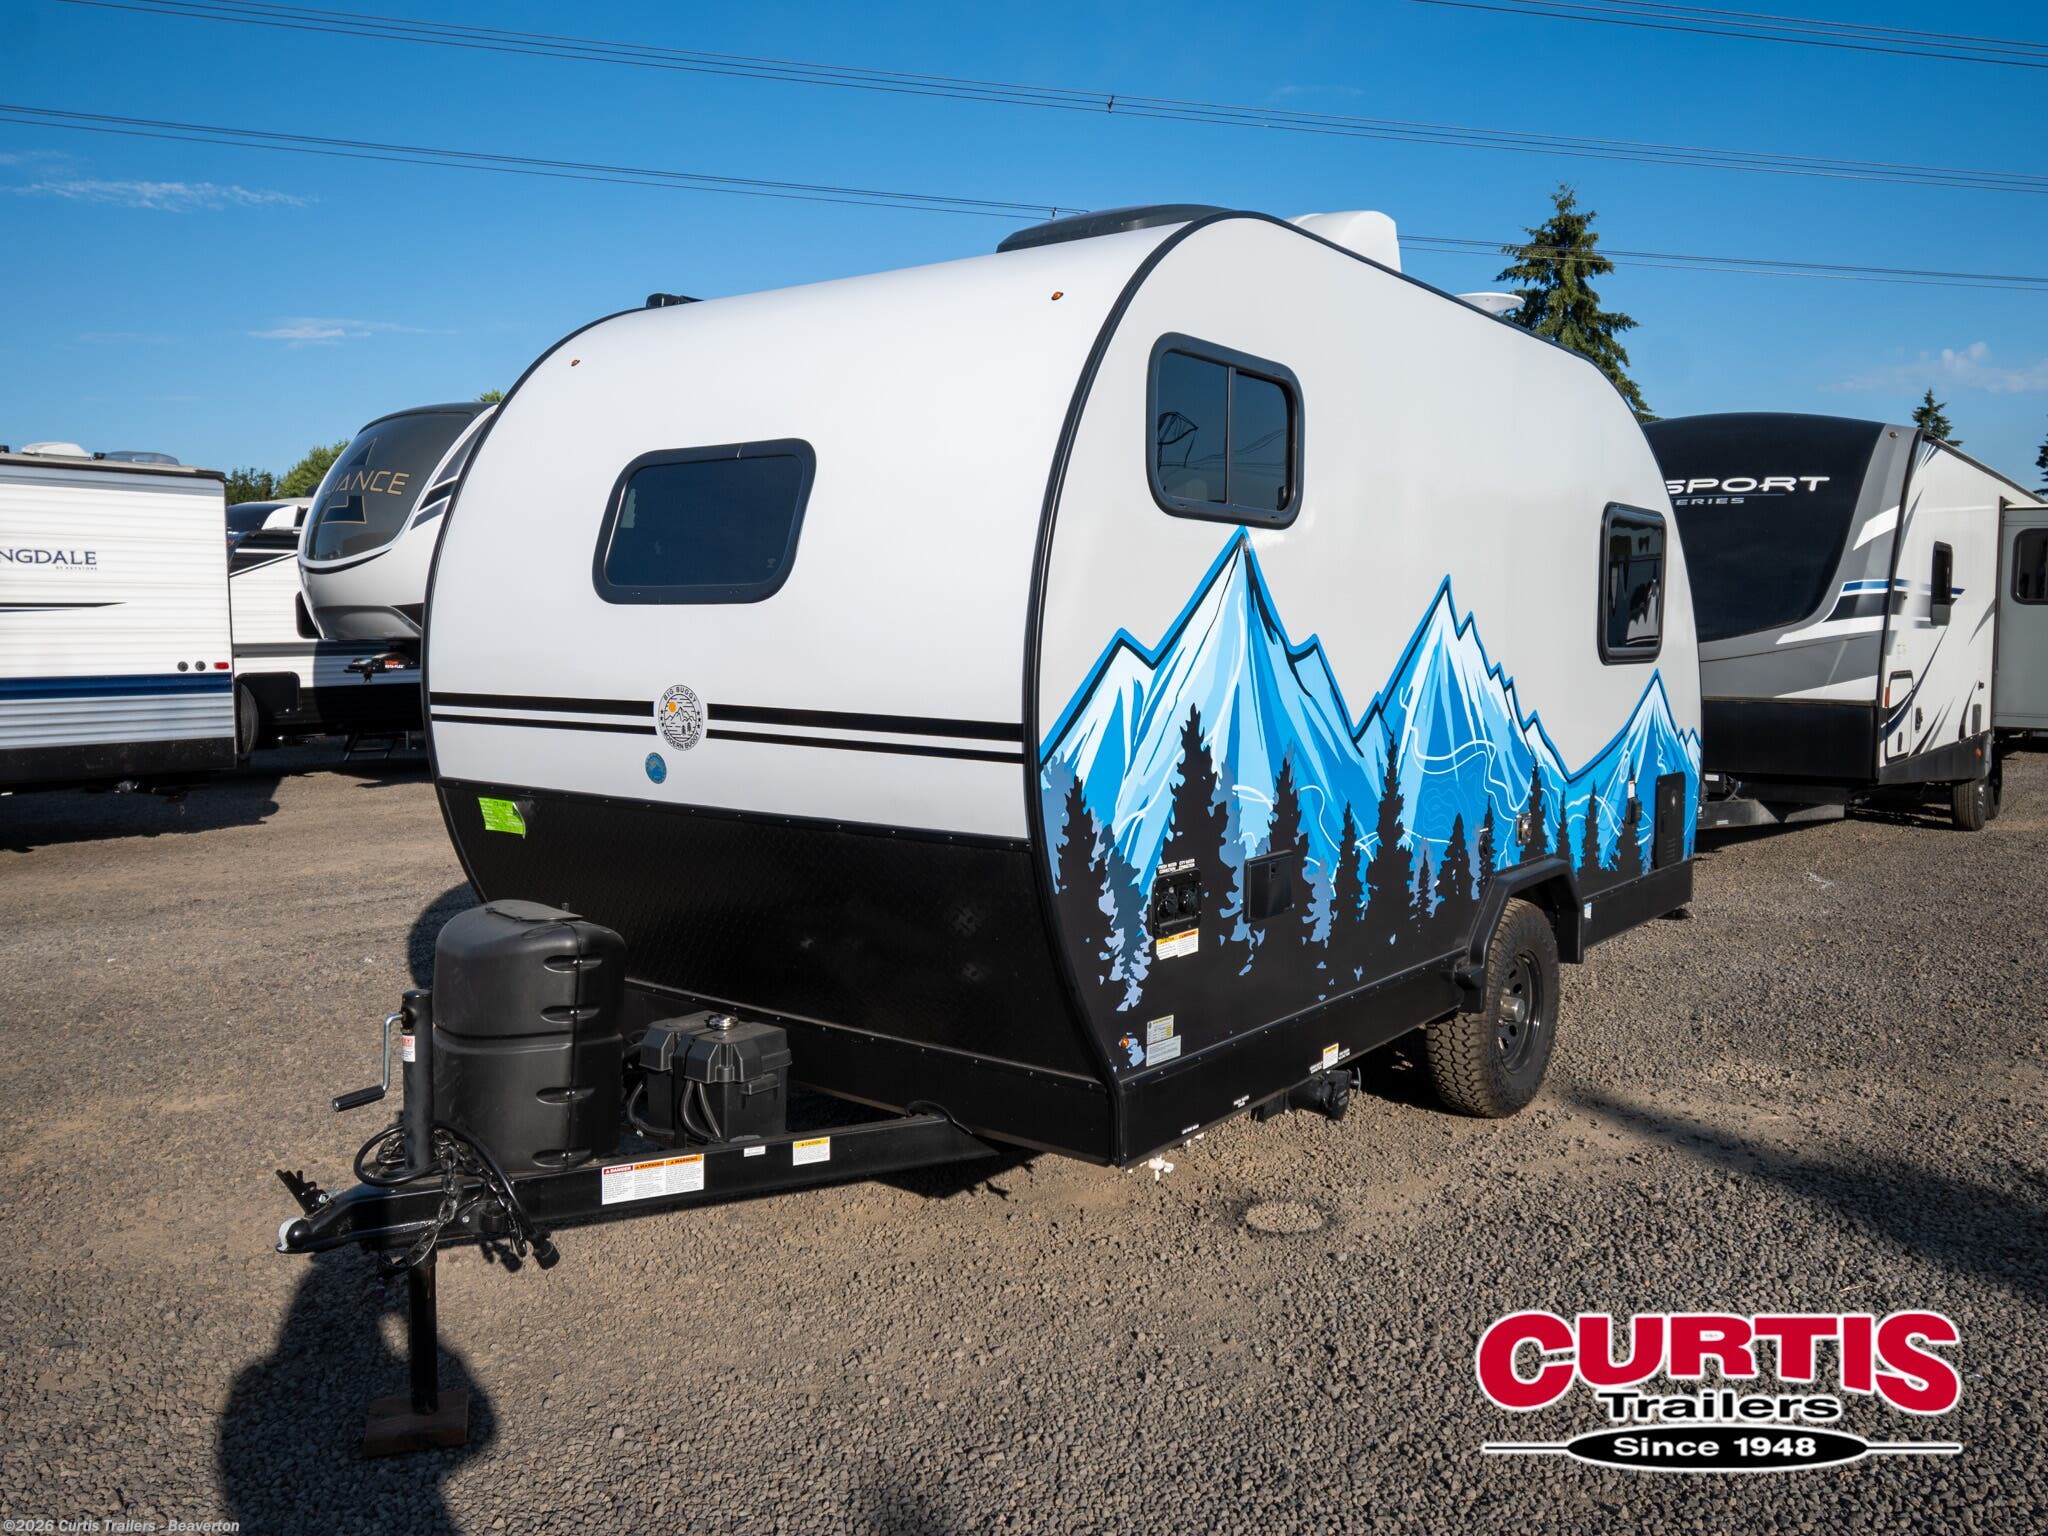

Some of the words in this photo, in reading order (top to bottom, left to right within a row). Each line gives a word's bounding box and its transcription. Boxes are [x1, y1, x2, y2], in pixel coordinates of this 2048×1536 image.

[1673, 497, 1745, 506] ERIES
[663, 688, 674, 701] BIG
[676, 687, 697, 702] BUGGY
